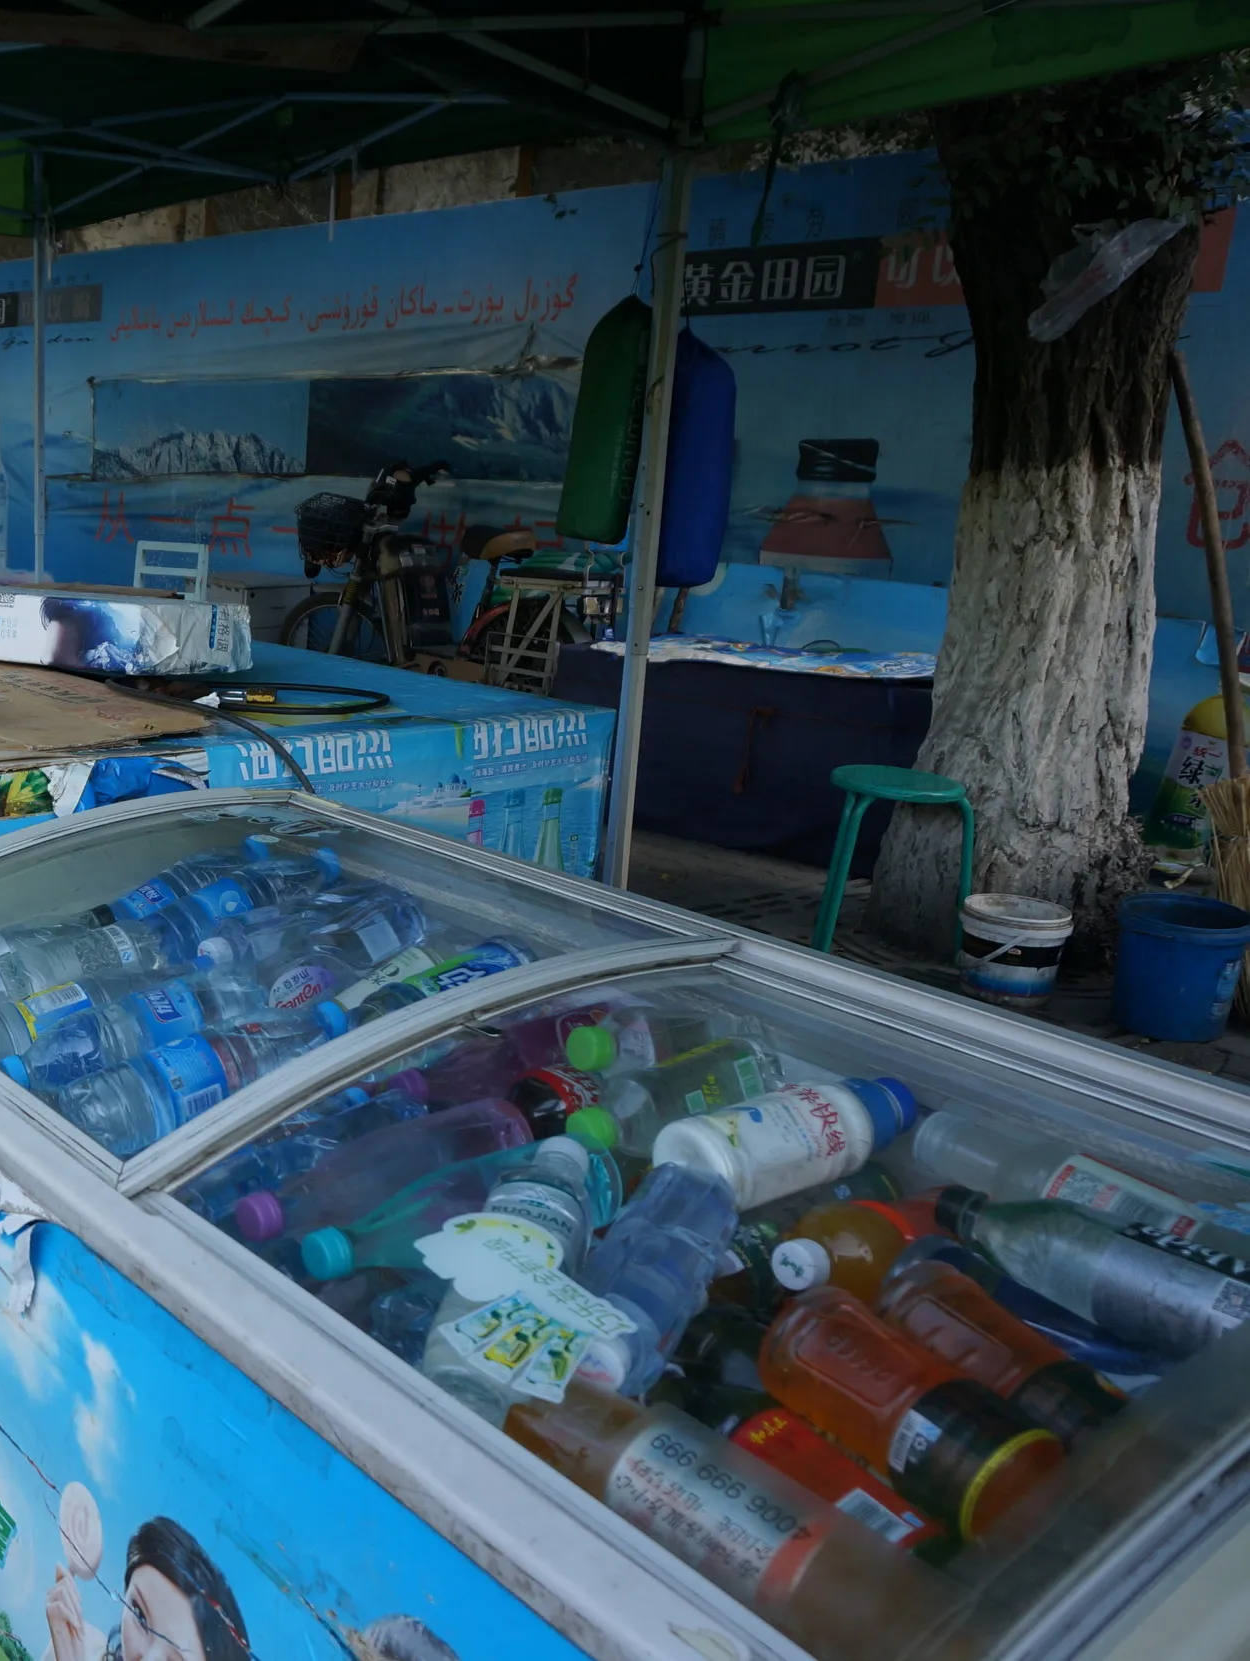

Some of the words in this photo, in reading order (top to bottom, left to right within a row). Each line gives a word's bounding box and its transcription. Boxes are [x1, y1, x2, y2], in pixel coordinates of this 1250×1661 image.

[682, 254, 846, 307] 黄金田园
[649, 1432, 699, 1469] 999
[697, 1463, 749, 1501] 999
[744, 1495, 813, 1542] 4006
